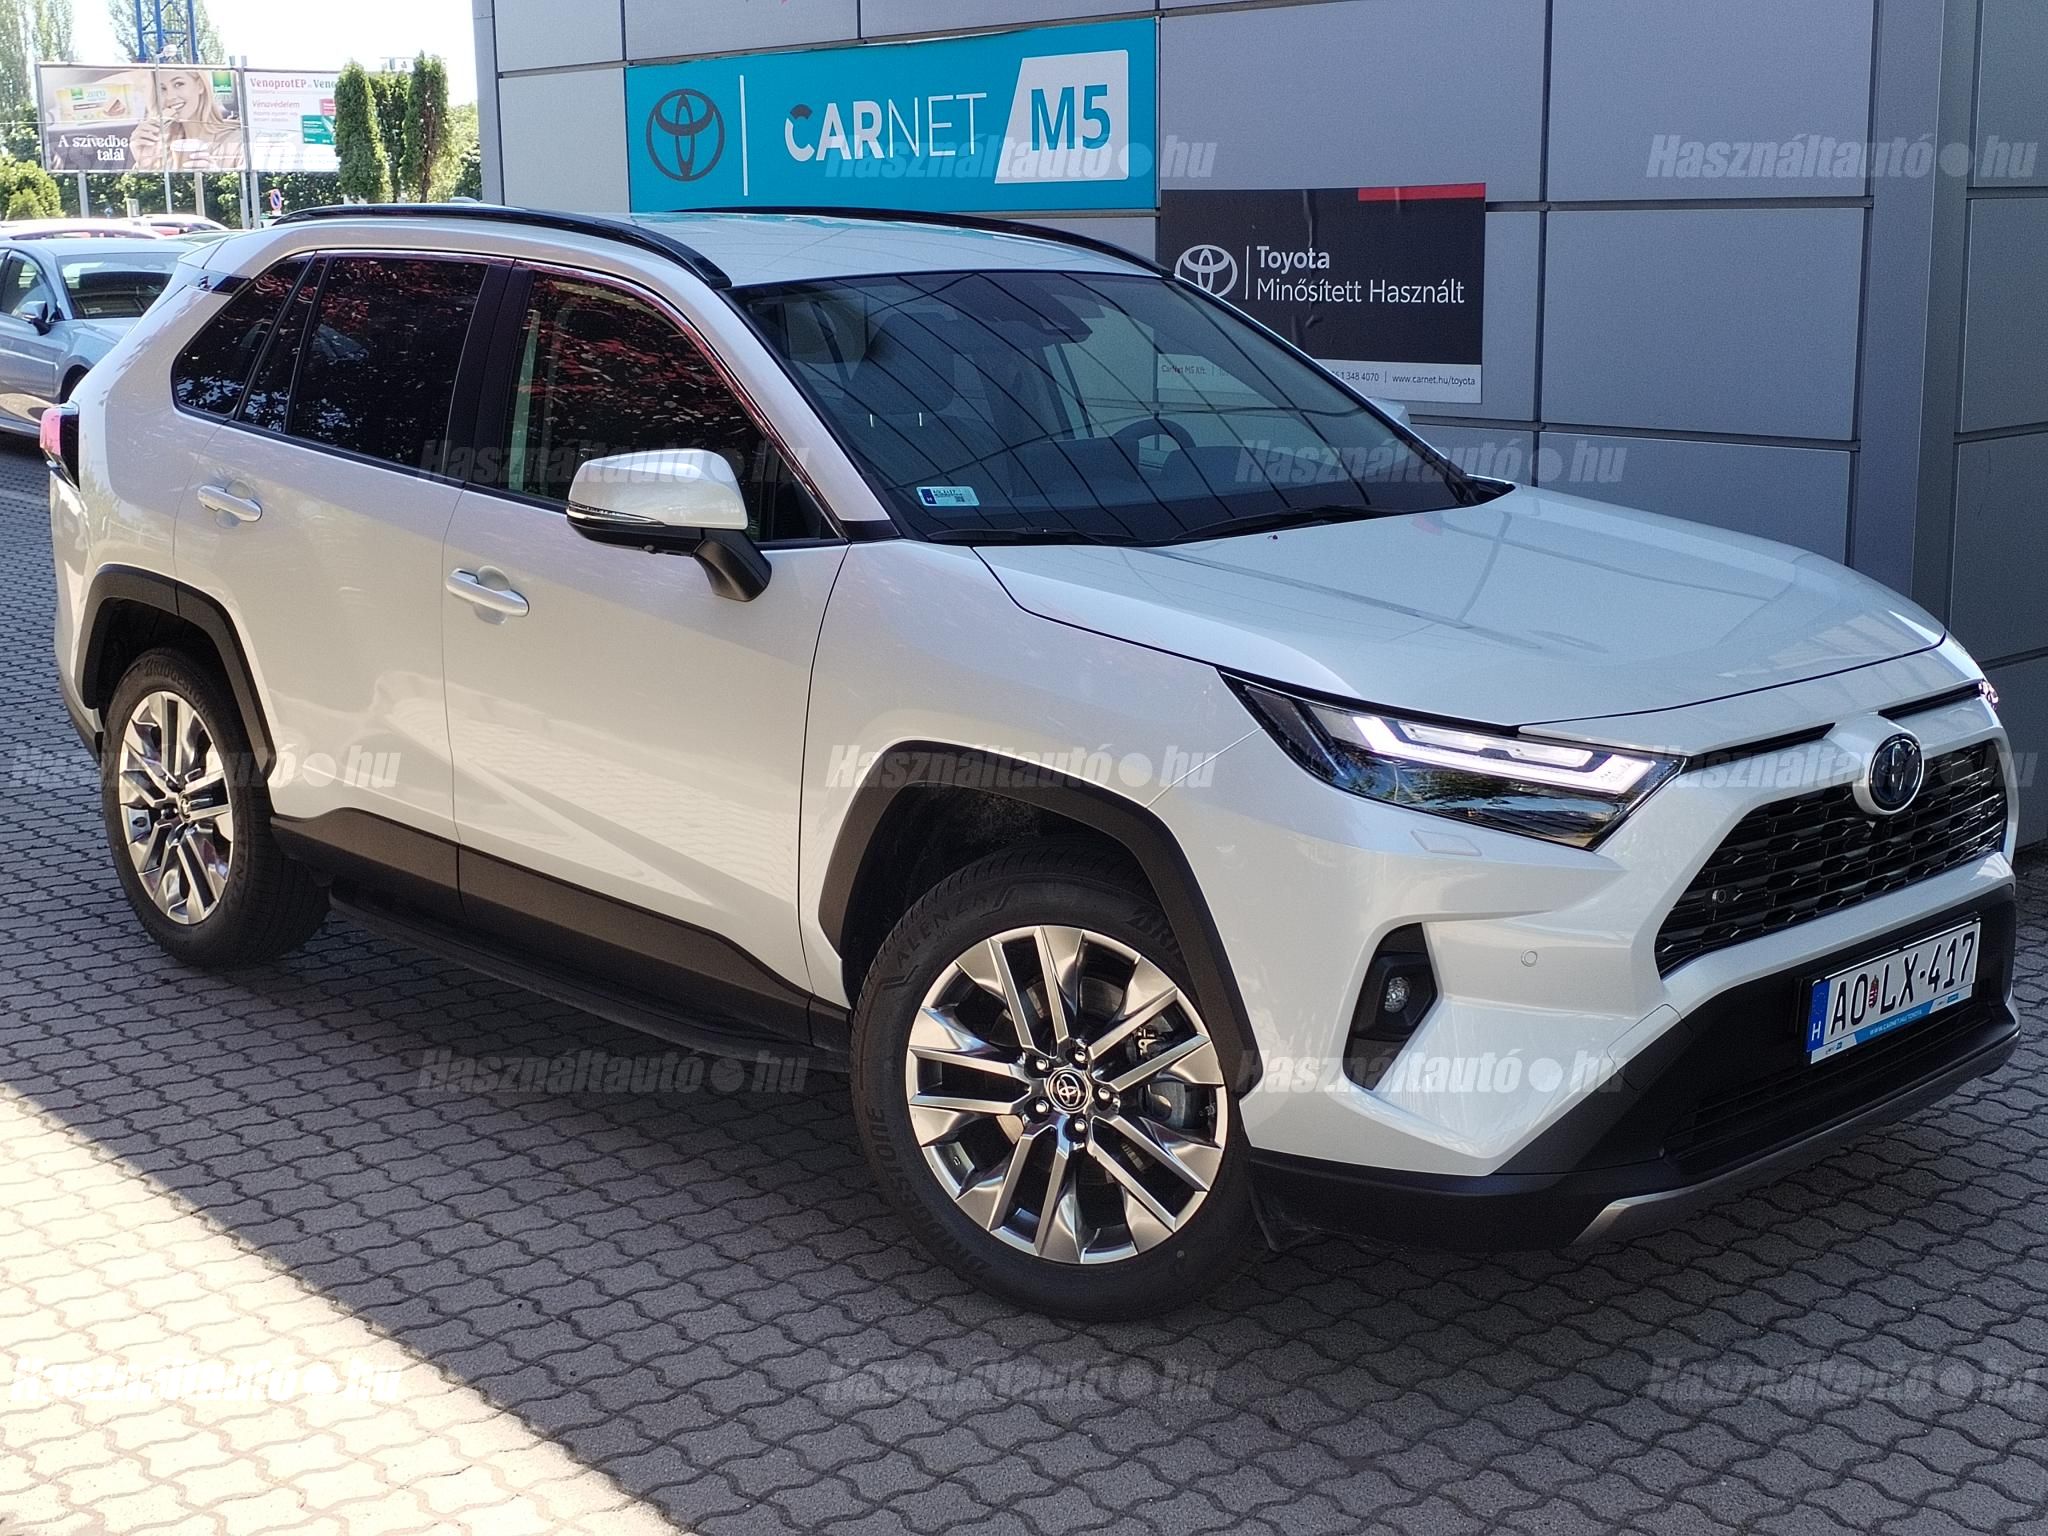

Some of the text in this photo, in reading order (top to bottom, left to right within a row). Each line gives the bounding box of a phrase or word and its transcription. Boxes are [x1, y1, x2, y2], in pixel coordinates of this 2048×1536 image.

[784, 83, 1112, 162] CARNET M5
[58, 135, 69, 147] A
[97, 148, 125, 161] talál
[1257, 245, 1330, 274] Toyota
[1257, 278, 1465, 304] Minősített Használt
[1361, 372, 1380, 382] 4070
[1392, 375, 1476, 387] www.carnet.hu/toyota
[1811, 1021, 1821, 1041] H
